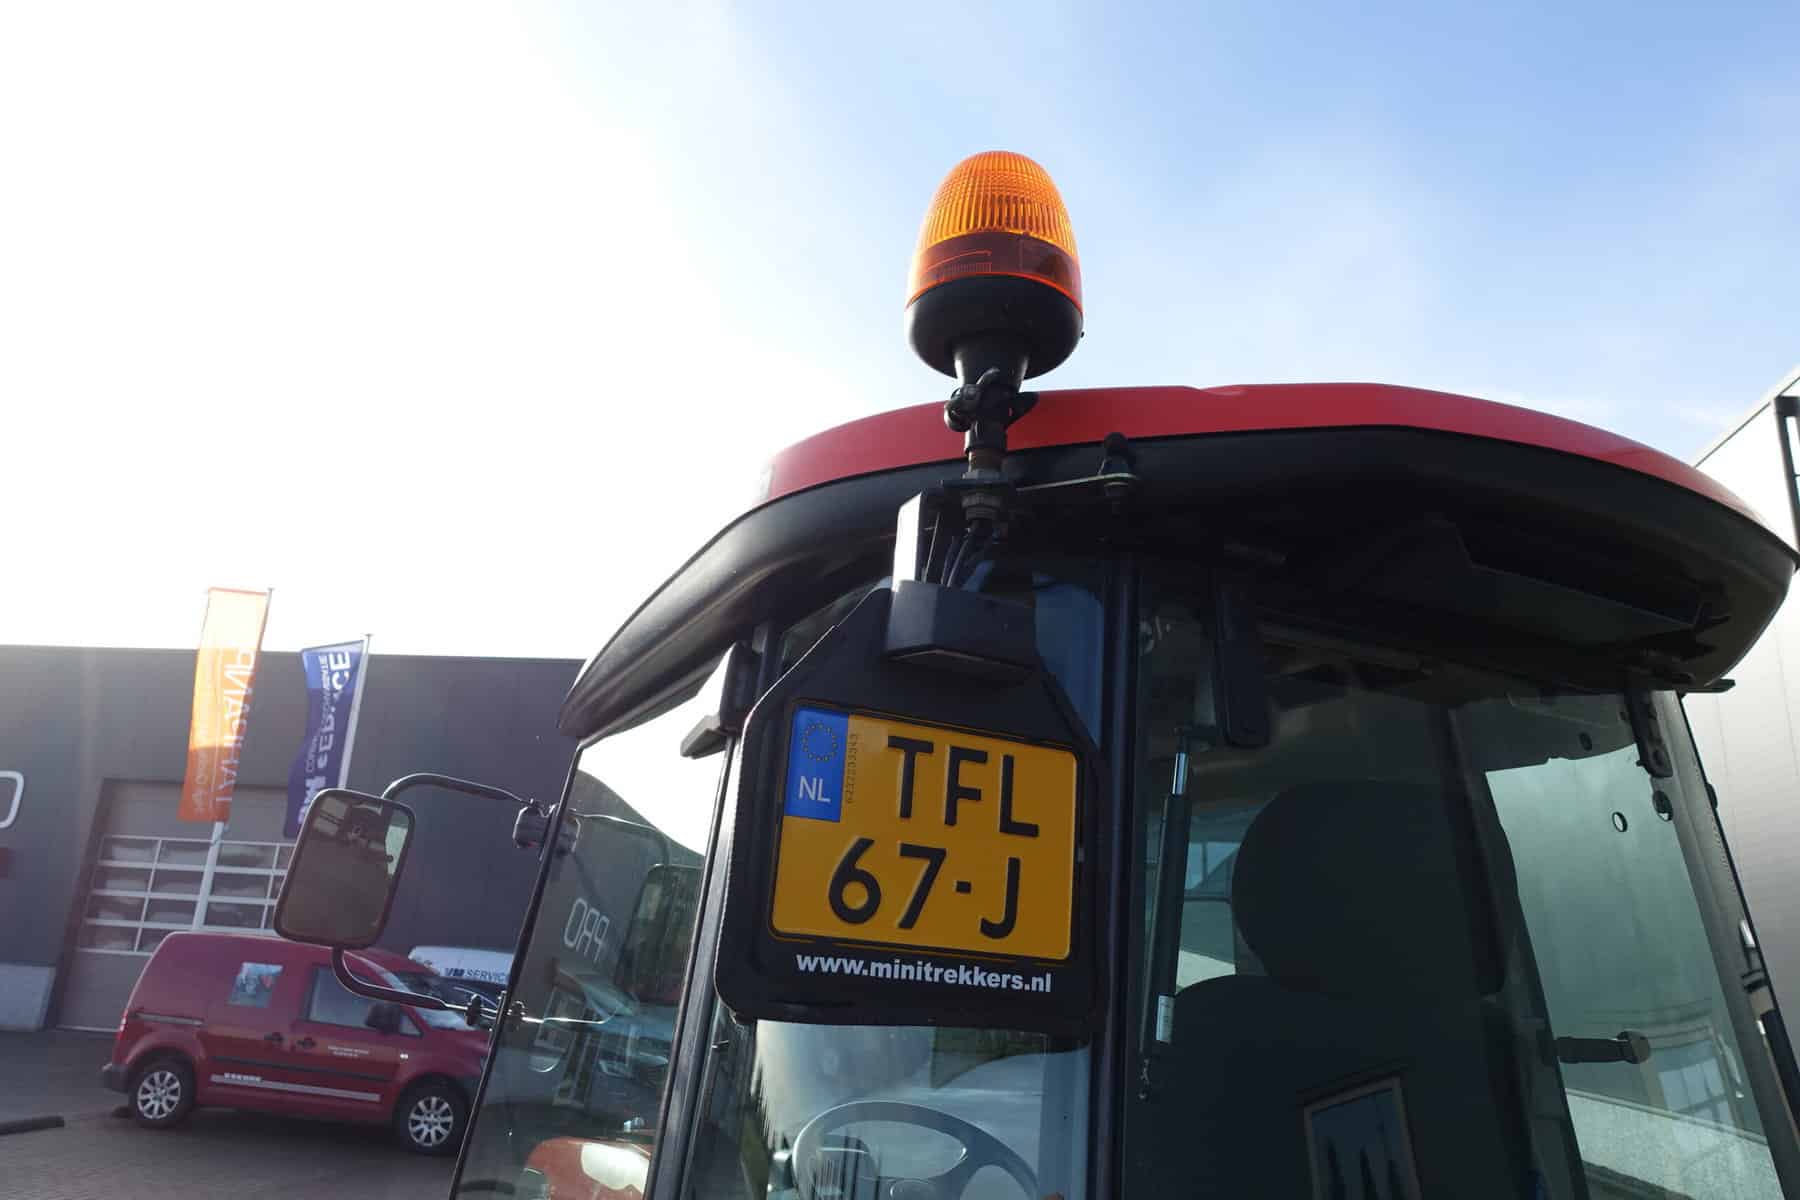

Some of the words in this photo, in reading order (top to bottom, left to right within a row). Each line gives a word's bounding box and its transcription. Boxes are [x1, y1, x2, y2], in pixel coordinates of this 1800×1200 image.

[797, 775, 832, 803] NL
[887, 735, 1040, 838] TFL
[795, 952, 1053, 993] www.minitrekkers.nl
